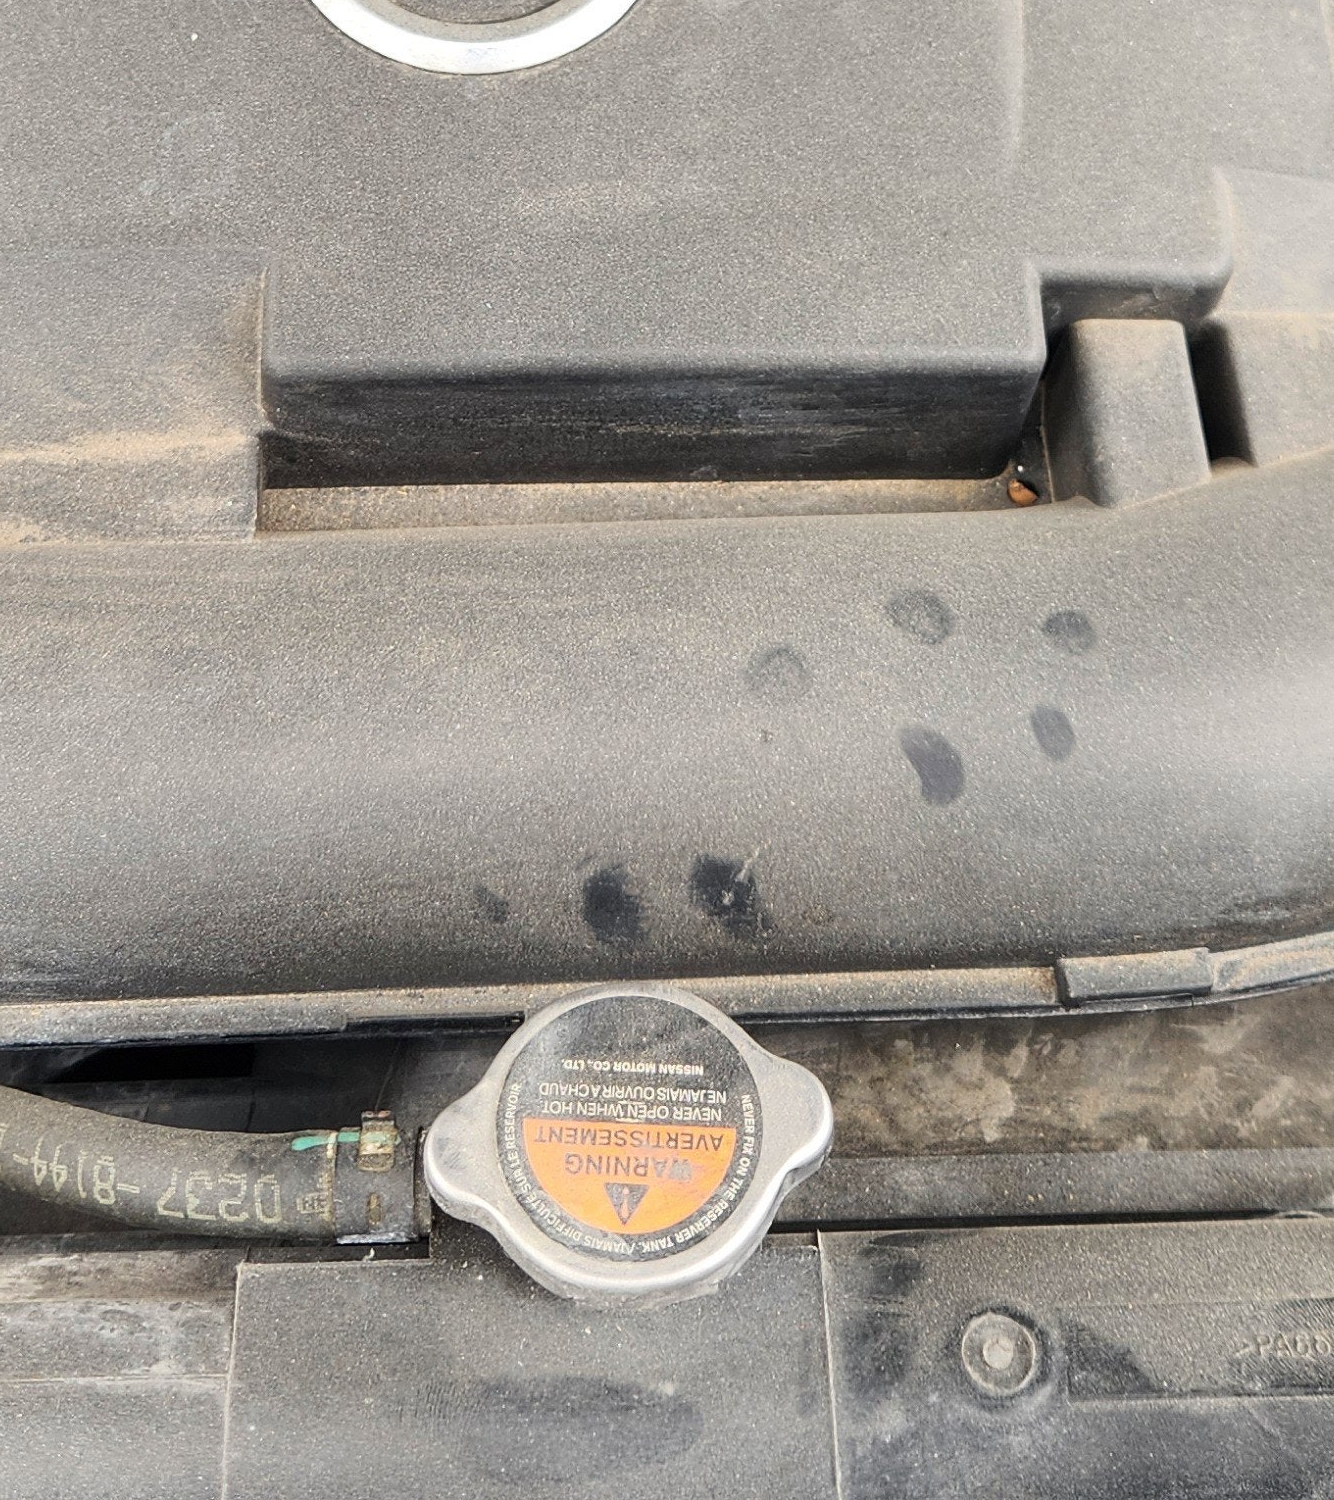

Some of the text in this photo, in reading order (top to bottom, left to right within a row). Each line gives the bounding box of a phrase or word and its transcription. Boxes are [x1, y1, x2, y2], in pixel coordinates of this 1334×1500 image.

[612, 1061, 658, 1074] MOTOR
[659, 1063, 704, 1076] NISSAN
[602, 1085, 655, 1100] OUVRIR
[656, 1087, 705, 1103] JAMAIS
[577, 1101, 625, 1118] WHEN
[627, 1104, 670, 1119] OPEN
[673, 1106, 722, 1122] NEVER
[534, 1126, 724, 1152] AVERTISSEMENT
[565, 1153, 694, 1182] WARNING
